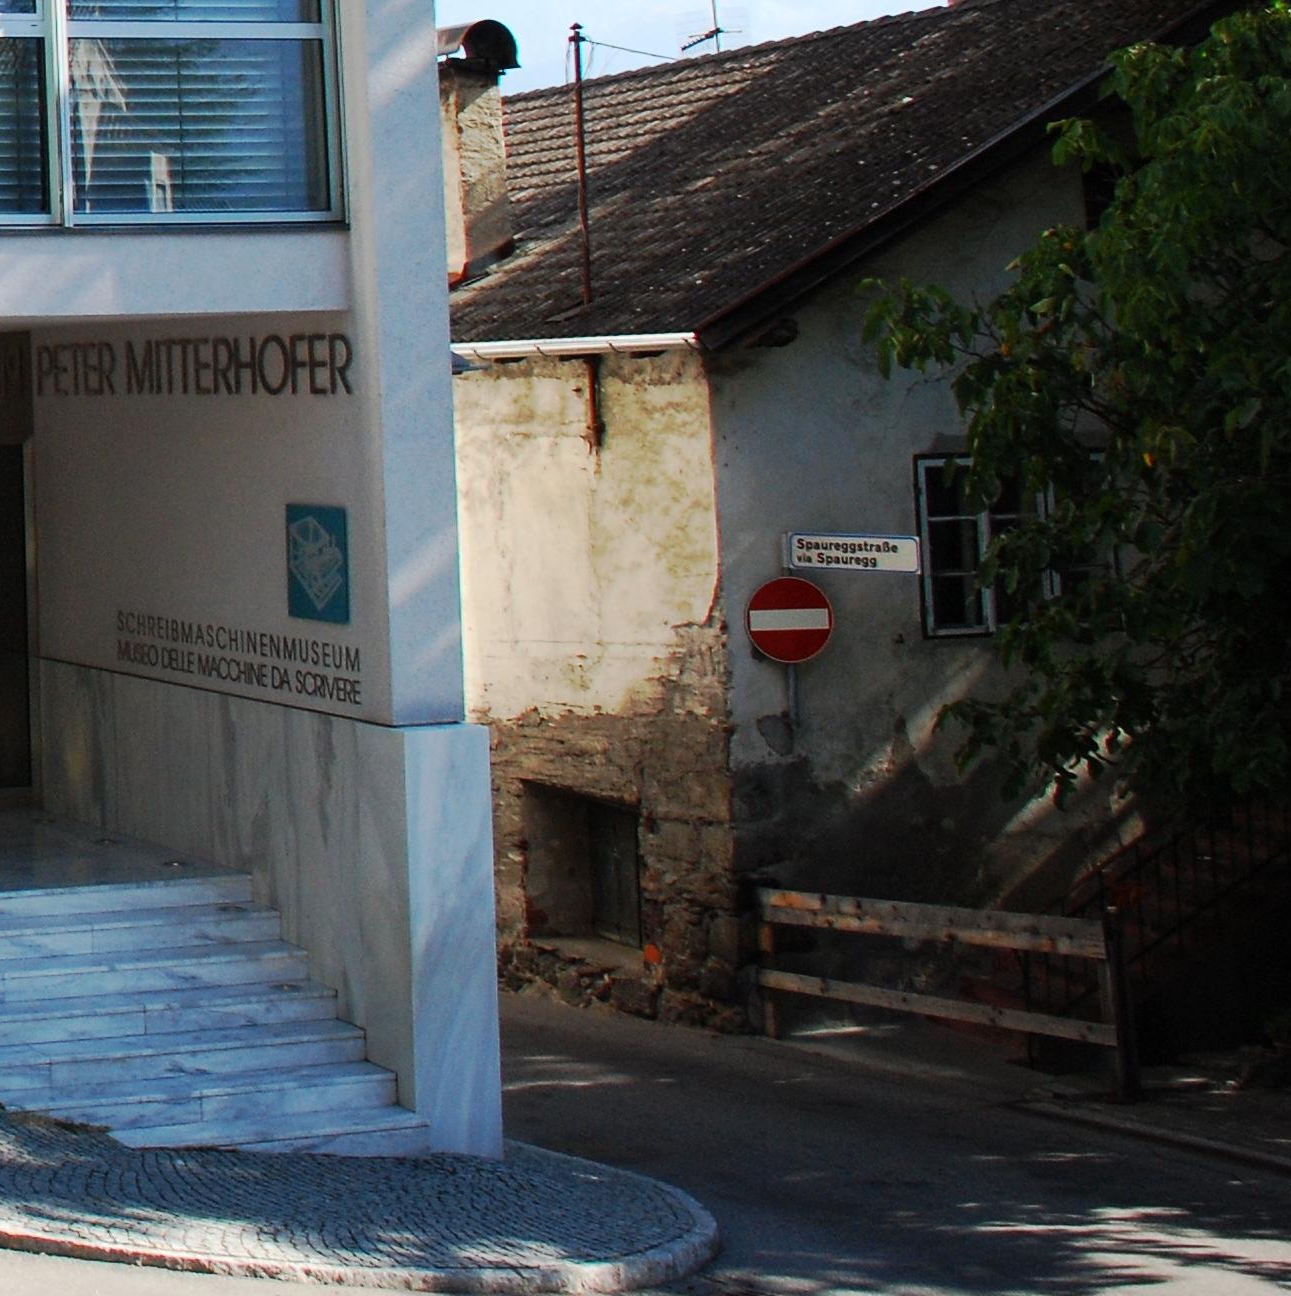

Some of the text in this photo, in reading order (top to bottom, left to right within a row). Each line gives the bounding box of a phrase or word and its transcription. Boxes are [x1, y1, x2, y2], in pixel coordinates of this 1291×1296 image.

[35, 332, 353, 397] PETER MITTERHOFER
[797, 538, 898, 553] Spaureggstraße
[797, 552, 877, 568] via Spauregg
[117, 610, 361, 673] SCHREIBMASCHINENMUSEUM
[117, 639, 362, 705] MUSEO DELLE MACCHINE DA SCRIVERE
